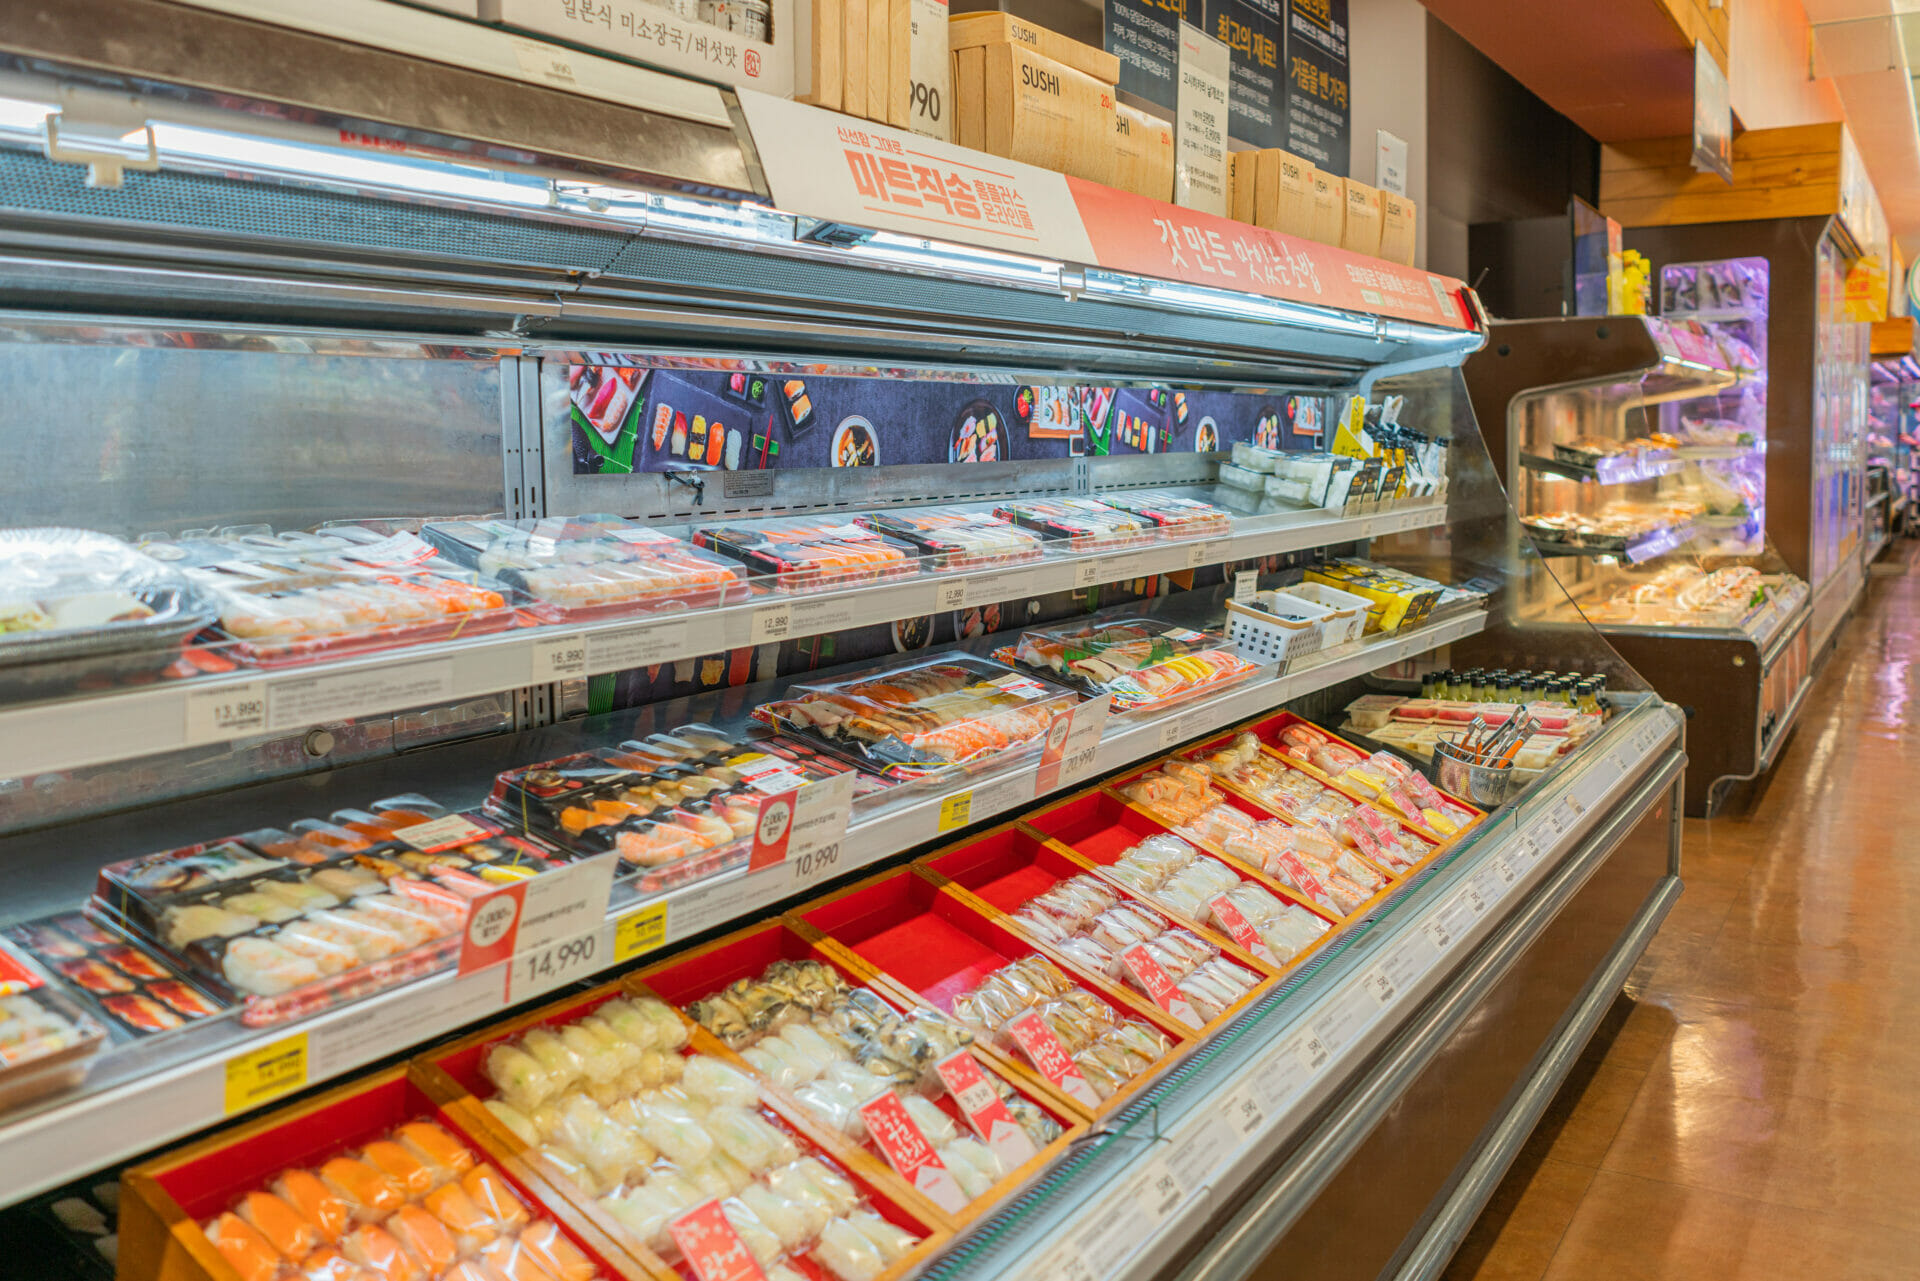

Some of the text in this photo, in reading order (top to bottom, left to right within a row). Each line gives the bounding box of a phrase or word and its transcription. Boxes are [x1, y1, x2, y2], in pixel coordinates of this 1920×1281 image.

[621, 12, 737, 68] 미소장국/버섯맛
[1011, 24, 1037, 45] SUSHI
[1217, 14, 1252, 60] 최고의
[1022, 64, 1060, 96] SUSHI
[1291, 56, 1318, 96] 거품을
[837, 126, 905, 156] 신선함 그대로
[844, 149, 982, 220] 마트직송
[1282, 162, 1299, 180] SUSHI
[972, 179, 1028, 209] 홈플러스
[982, 201, 1035, 231] 온라인몰
[1153, 218, 1322, 295] 갓 만든 맛있는 초밥
[946, 588, 964, 600] 12,990
[764, 616, 789, 629] 12,990
[551, 649, 585, 665] 16,990
[214, 700, 264, 721] 13,990
[795, 843, 839, 878] 10,990
[528, 935, 595, 981] 14,990
